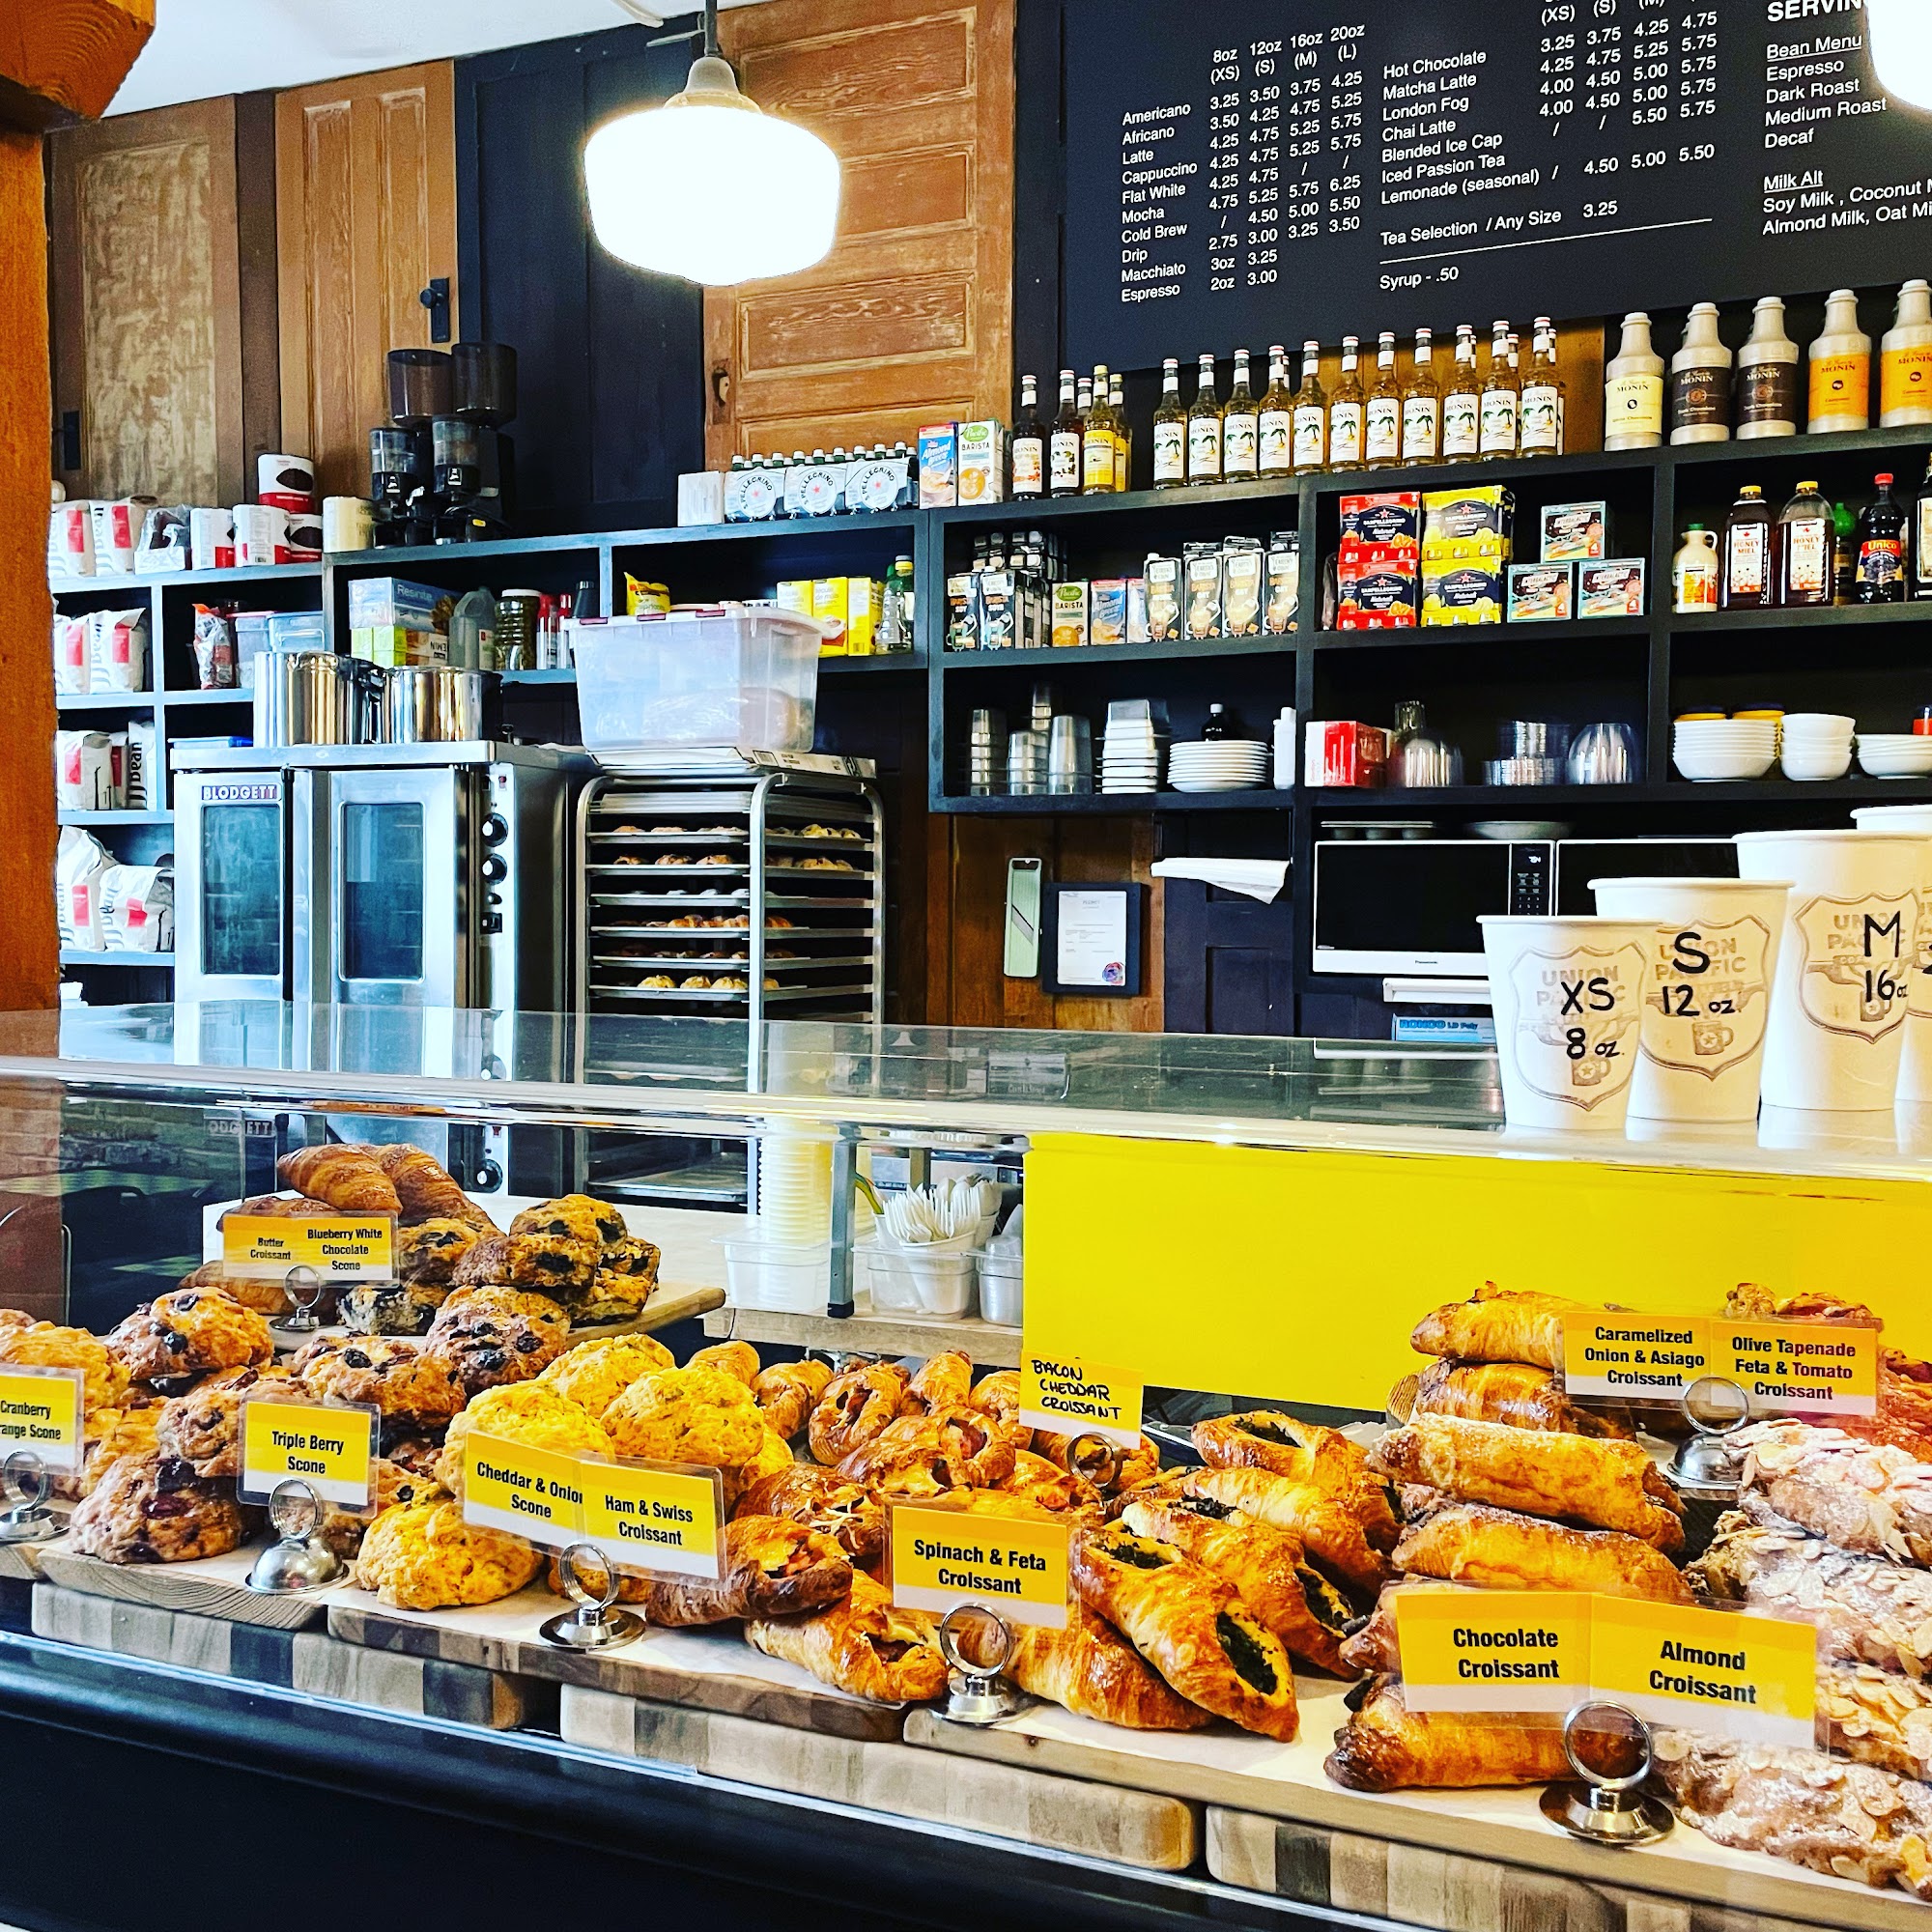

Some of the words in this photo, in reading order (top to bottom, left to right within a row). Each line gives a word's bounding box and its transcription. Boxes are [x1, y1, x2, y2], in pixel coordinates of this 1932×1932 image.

[1542, 5, 1575, 26] (XS)
[1594, 0, 1615, 17] (S)
[1768, 0, 1861, 21] SERVIN
[1213, 49, 1237, 63] 8oz
[1250, 41, 1282, 55] 12oz
[1291, 33, 1322, 48] 16oz
[1331, 25, 1364, 42] 20oz
[1384, 63, 1408, 79] Hot
[1413, 51, 1486, 73] Chocolate
[1541, 34, 1575, 52] 3.25
[1682, 12, 1717, 29] 4.75
[1767, 43, 1810, 59] Bean
[1815, 35, 1862, 52] Menu
[1210, 66, 1239, 85] (XS)
[1256, 59, 1274, 76] (S)
[1294, 51, 1317, 70] (M)
[1339, 43, 1356, 62] (L)
[1383, 80, 1435, 99] Matcha
[1440, 73, 1476, 91] Latte
[1541, 56, 1574, 73] 4.25
[1682, 34, 1717, 51] 5.75
[1767, 61, 1844, 82] Espresso
[1383, 102, 1436, 121] London
[1441, 98, 1468, 111] Fog
[1540, 78, 1574, 95] 4.00
[1682, 55, 1716, 73] 5.75
[1767, 85, 1804, 103] Dark
[1811, 78, 1860, 98] Roast
[1122, 104, 1190, 126] Americano
[1210, 93, 1239, 109] 3.25
[1382, 124, 1415, 141] Chai
[1420, 120, 1456, 135] Latte
[1540, 99, 1573, 116] 4.00
[1681, 77, 1716, 96] 5.75
[1766, 106, 1831, 127] Medium
[1837, 98, 1887, 116] Roast
[1122, 128, 1174, 145] Africano
[1210, 113, 1239, 129] 3.50
[1382, 141, 1440, 162] Blended
[1446, 139, 1467, 153] Ice
[1472, 134, 1502, 149] Cap
[1680, 99, 1716, 117] 5.75
[1765, 128, 1813, 148] Decaf
[1122, 150, 1153, 164] Latte
[1210, 133, 1238, 149] 4.25
[1122, 162, 1197, 185] Cappuccino
[1209, 154, 1238, 169] 4.25
[1381, 182, 1457, 204] Lemonade
[1463, 168, 1539, 195] (seasonal)
[1679, 144, 1715, 161] 5.50
[1382, 166, 1411, 183] Iced
[1417, 159, 1474, 178] Passion
[1478, 155, 1505, 168] Tea
[1764, 175, 1797, 191] Milk
[1801, 170, 1824, 185] Alt
[1122, 189, 1146, 204] Flat
[1150, 184, 1185, 199] White
[1209, 174, 1238, 189] 4.25
[1763, 198, 1796, 213] Soy
[1801, 191, 1833, 208] Milk
[1850, 181, 1921, 202] Coconut
[1122, 207, 1164, 223] Mocha
[1209, 194, 1238, 210] 4.75
[1763, 213, 1826, 235] Almond
[1832, 210, 1869, 226] Milk,
[1876, 205, 1907, 221] Oat
[1122, 227, 1151, 243] Cold
[1155, 224, 1187, 238] Brew
[1380, 232, 1406, 245] Tea
[1410, 222, 1477, 242] Selection
[1494, 216, 1523, 230] Any
[1529, 211, 1561, 225] Size
[1583, 200, 1617, 217] 3.25
[1122, 248, 1148, 263] Drip
[1208, 234, 1237, 250] 2.75
[1122, 263, 1185, 282] Macchiato
[1211, 258, 1235, 270] 3oz
[1380, 274, 1421, 291] Syrup
[1436, 267, 1459, 281] .50
[1122, 285, 1179, 302] Espresso
[1211, 277, 1235, 290] 2oz
[1617, 384, 1650, 393] MONIN
[1681, 375, 1714, 385] MONIN
[1747, 371, 1780, 382] MONIN
[961, 441, 990, 451] BARISTA
[1793, 536, 1820, 545] HONEY
[1867, 539, 1897, 551] Unico
[203, 784, 277, 801] BLODGETT
[1864, 910, 1901, 958] M
[1672, 931, 1711, 974] S
[1560, 977, 1615, 1016] XS
[1662, 983, 1701, 1017] 12
[1566, 1027, 1586, 1060] 8
[257, 1236, 285, 1248] Butter
[307, 1229, 354, 1240] Blueberry
[355, 1228, 383, 1239] White
[250, 1249, 291, 1261] Croissant
[323, 1244, 369, 1255] Chocolate
[331, 1260, 361, 1270] Scone
[1595, 1325, 1693, 1345] Caramelized
[1732, 1336, 1773, 1352] Olive
[1776, 1338, 1856, 1357] Tapenade
[1031, 1359, 1083, 1381] BACON
[1584, 1347, 1630, 1363] Onion
[1634, 1349, 1646, 1364] &
[1650, 1350, 1705, 1368] Asiago
[1735, 1358, 1770, 1375] Feta
[1776, 1361, 1788, 1376] &
[1792, 1361, 1854, 1379] Tomato
[1039, 1378, 1111, 1402] CHEDDAR
[1607, 1369, 1683, 1387] Croissant
[1754, 1380, 1834, 1401] Croissant
[0, 1400, 51, 1420] Cranberry
[1040, 1396, 1122, 1420] CROISSANT
[30, 1424, 61, 1440] Scone
[271, 1431, 306, 1450] Triple
[309, 1435, 345, 1455] Berry
[287, 1456, 327, 1475] Scone
[476, 1462, 532, 1490] Cheddar
[535, 1477, 546, 1494] &
[511, 1493, 552, 1519] Scone
[605, 1494, 635, 1515] Ham
[639, 1499, 649, 1516] &
[653, 1501, 694, 1523] Swiss
[618, 1520, 683, 1547] Croissant
[914, 1539, 983, 1564] Spinach
[989, 1548, 1003, 1566] &
[1009, 1549, 1046, 1572] Feta
[938, 1568, 1022, 1595] Croissant
[1453, 1628, 1559, 1649] Chocolate
[1660, 1639, 1747, 1671] Almond
[1458, 1659, 1560, 1680] Croissant
[1648, 1669, 1757, 1705] Croissant
